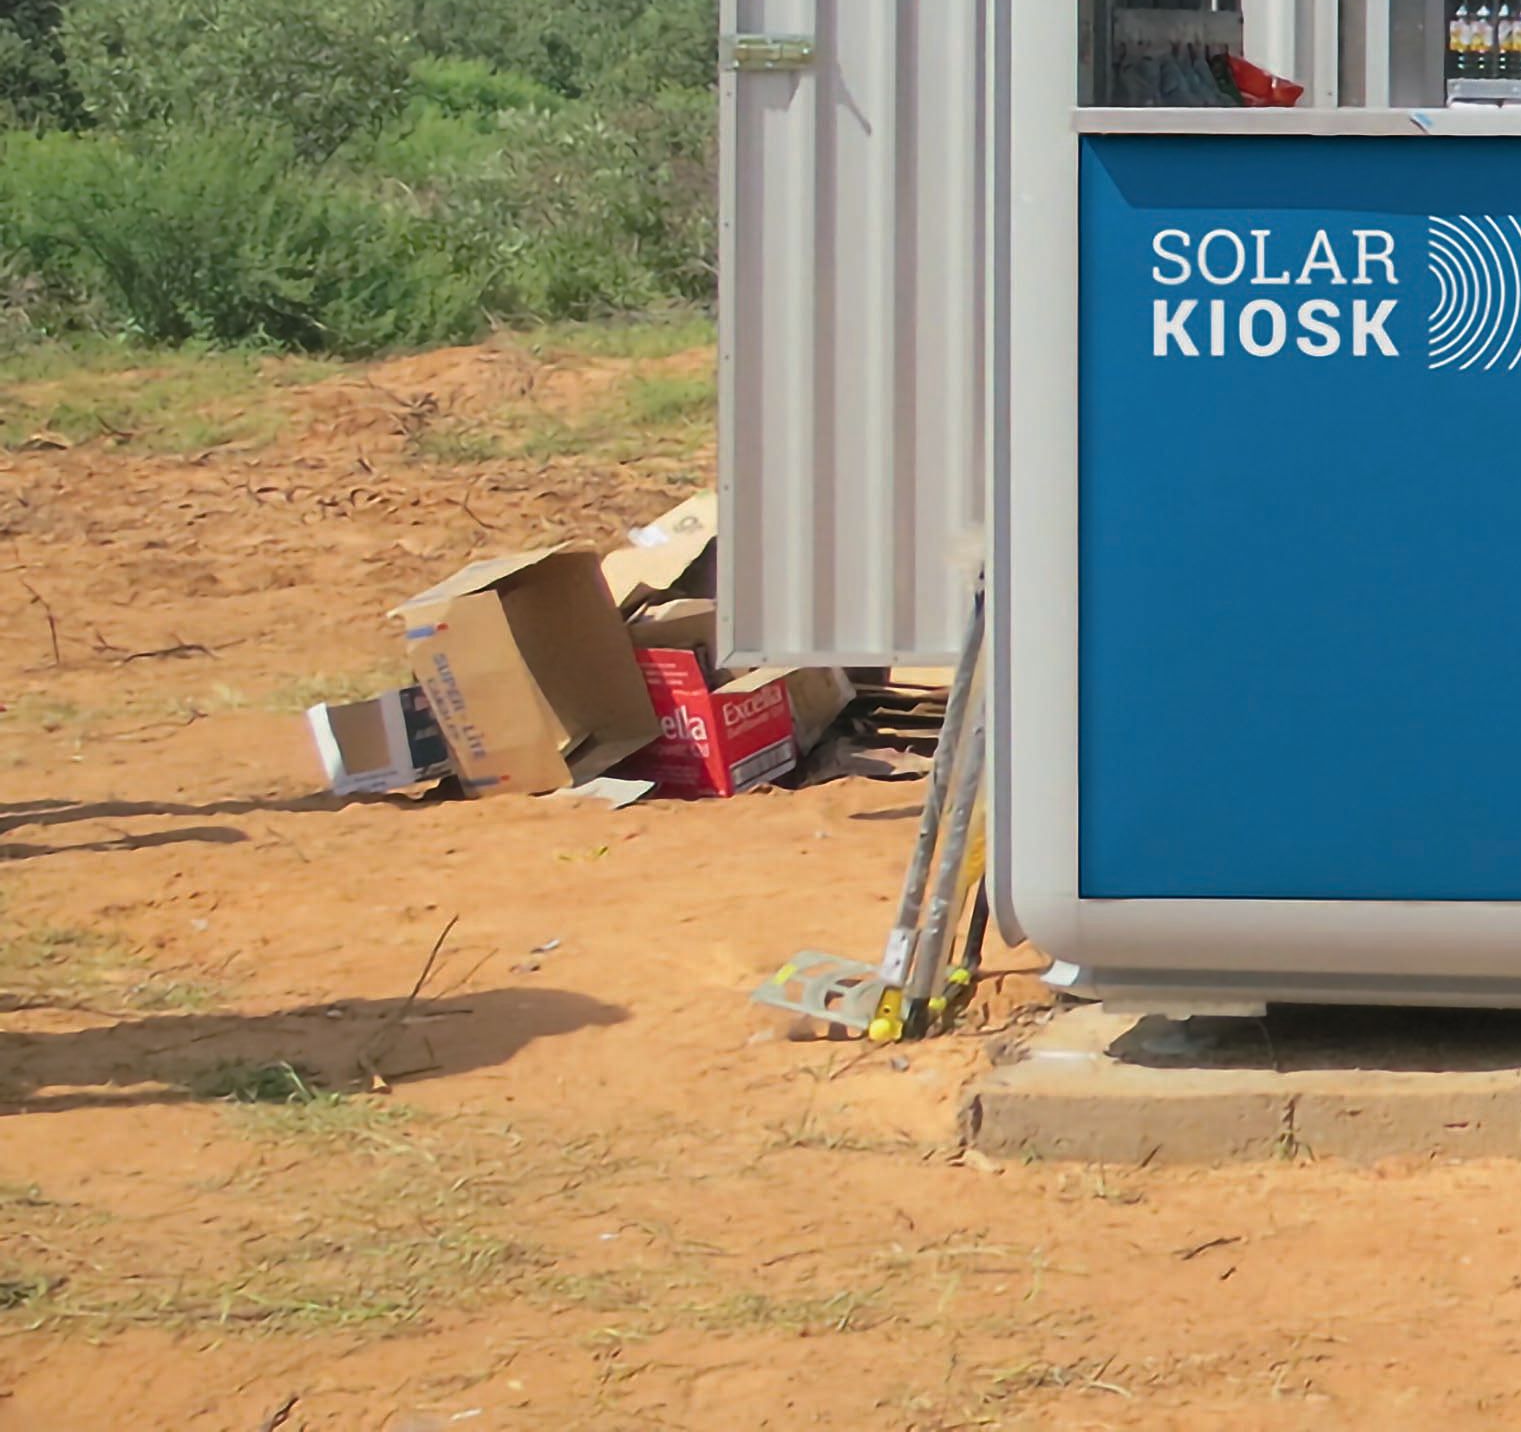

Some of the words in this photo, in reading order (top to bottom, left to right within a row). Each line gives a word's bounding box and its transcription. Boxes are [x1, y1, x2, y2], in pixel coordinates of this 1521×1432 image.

[1152, 229, 1399, 286] SOLAR
[1152, 299, 1399, 358] KIOSK
[660, 704, 708, 741] ella
